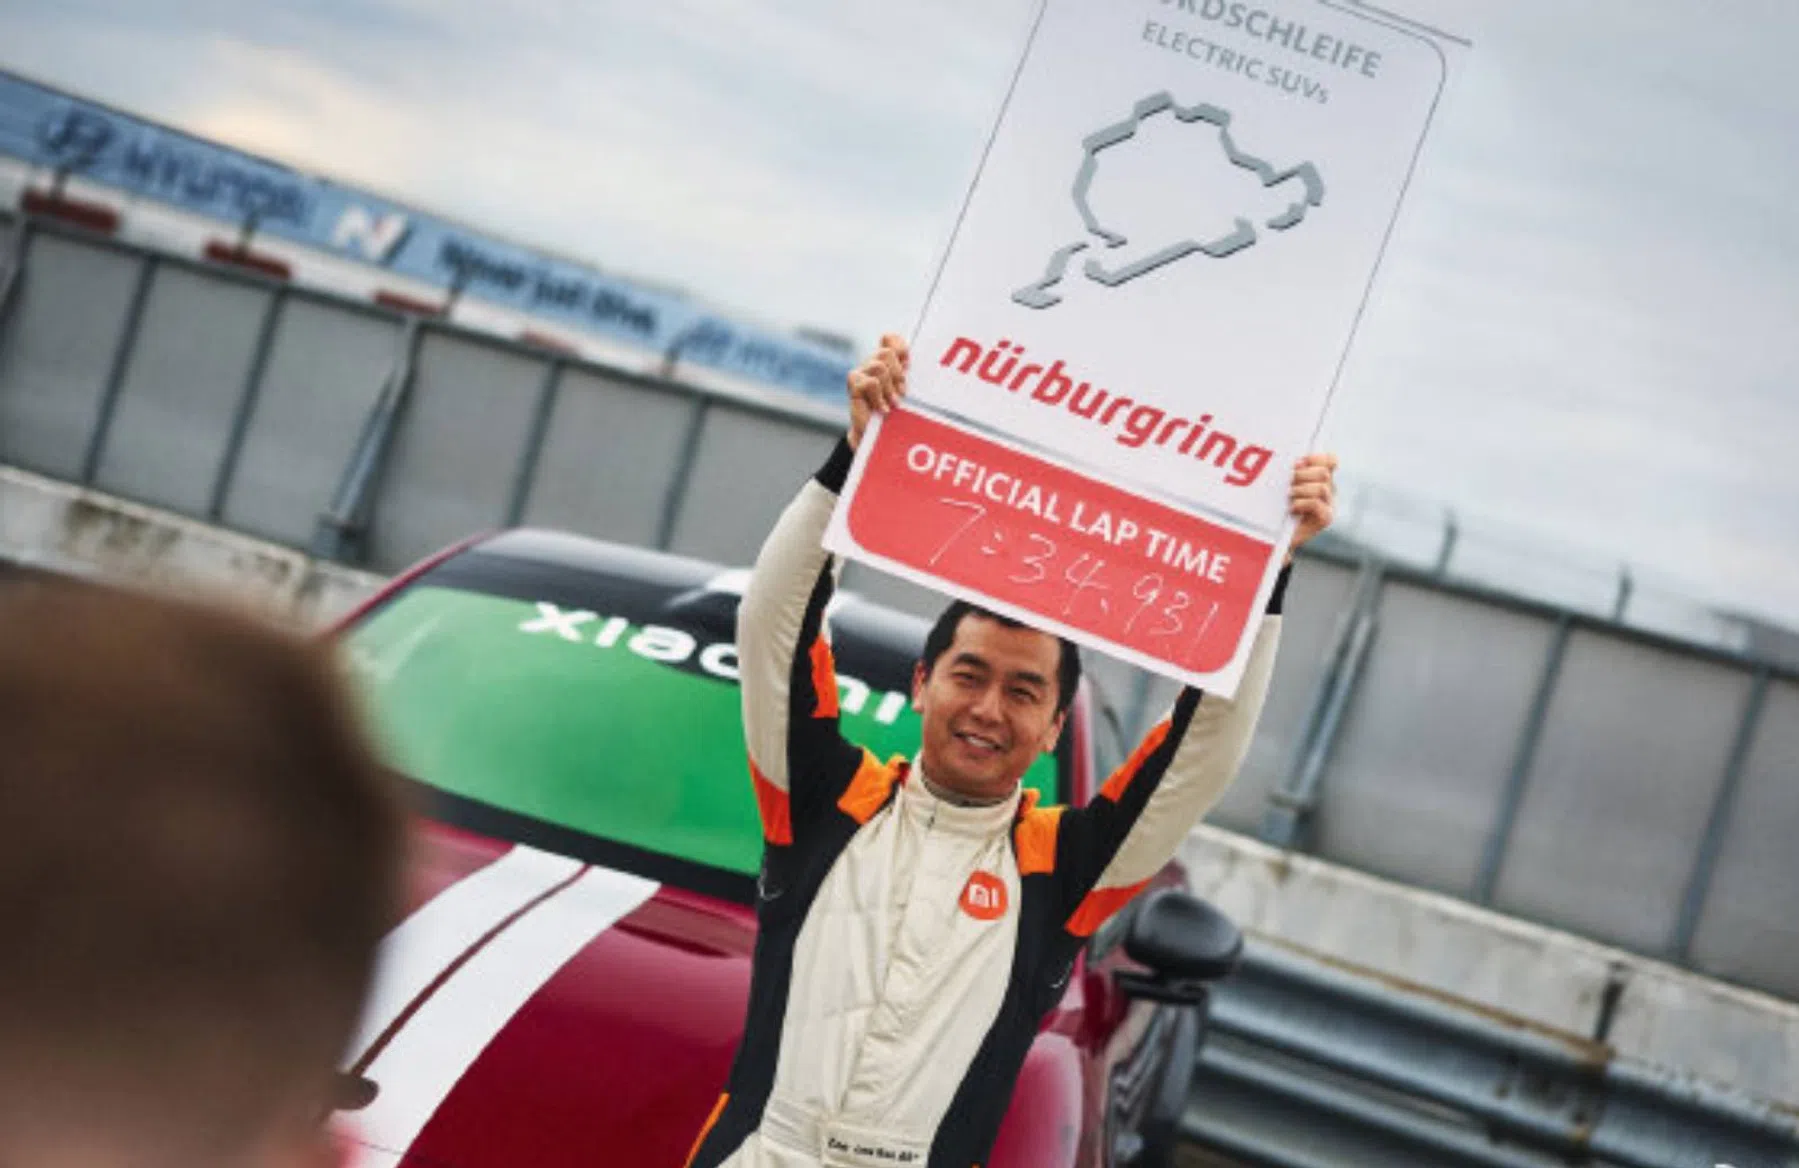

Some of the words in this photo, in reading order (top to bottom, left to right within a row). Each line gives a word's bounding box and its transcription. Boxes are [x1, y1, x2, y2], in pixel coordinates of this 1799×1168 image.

[1142, 19, 1264, 79] ELECTRIC
[1264, 64, 1330, 104] SUVs
[940, 336, 1274, 487] nürburgring
[907, 443, 1061, 524] OFFICIAL
[1068, 500, 1139, 546] LAP
[1145, 528, 1231, 584] TIME
